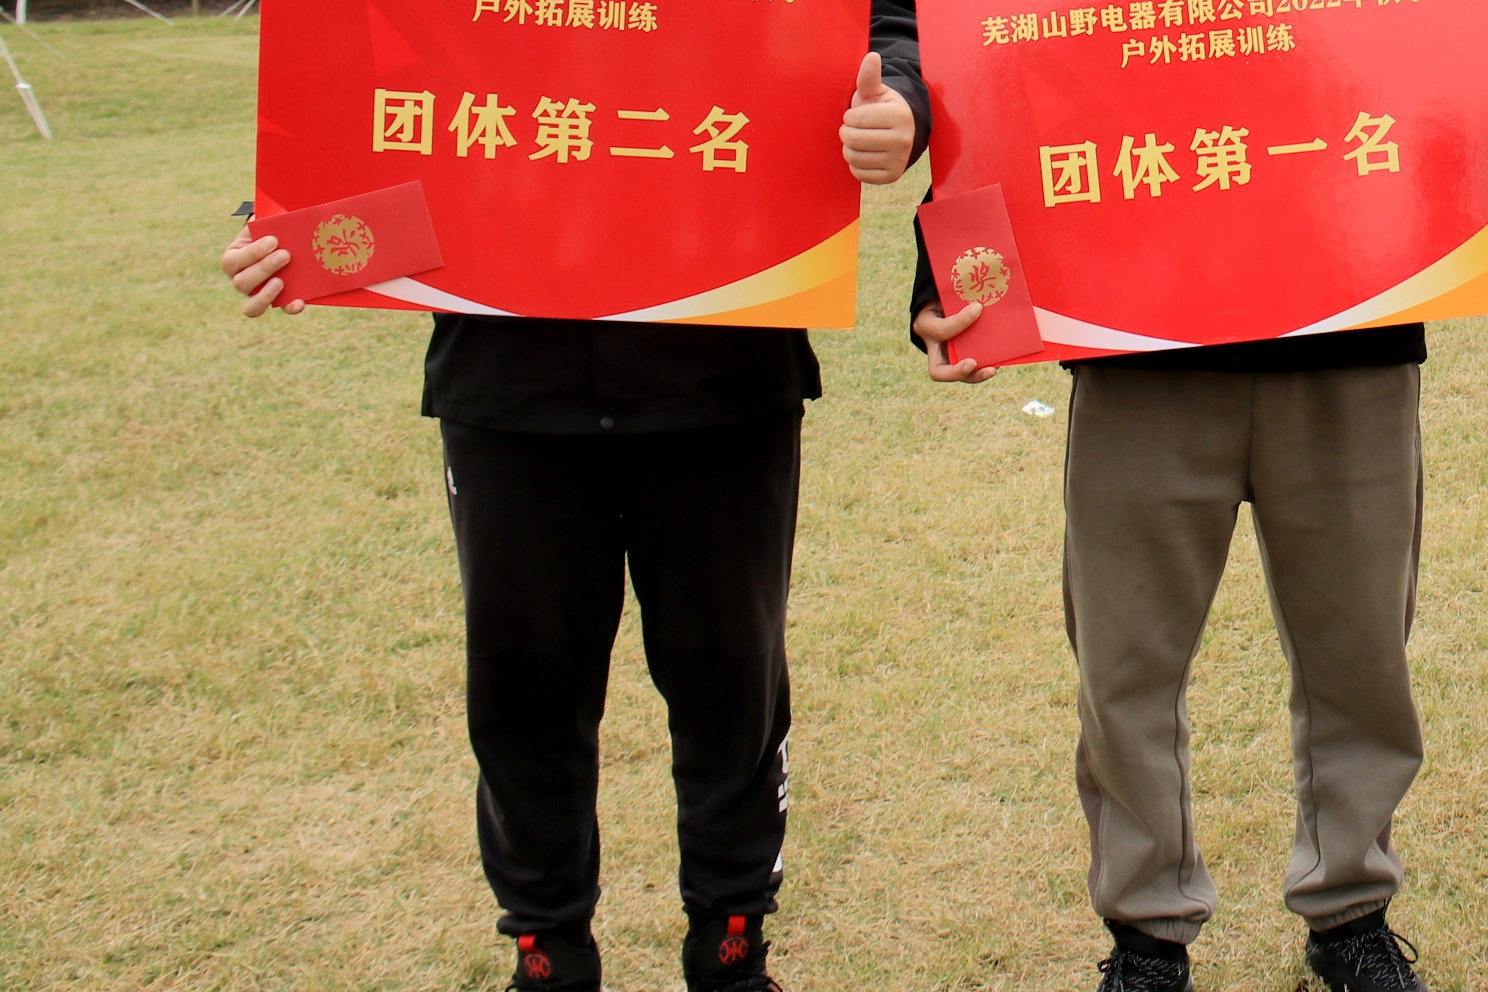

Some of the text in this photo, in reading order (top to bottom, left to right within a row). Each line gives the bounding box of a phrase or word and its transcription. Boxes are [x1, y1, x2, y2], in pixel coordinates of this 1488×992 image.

[1121, 23, 1296, 68] 户外拓展训练
[372, 88, 751, 173] 团体第二名
[1039, 112, 1401, 208] 团体第一名
